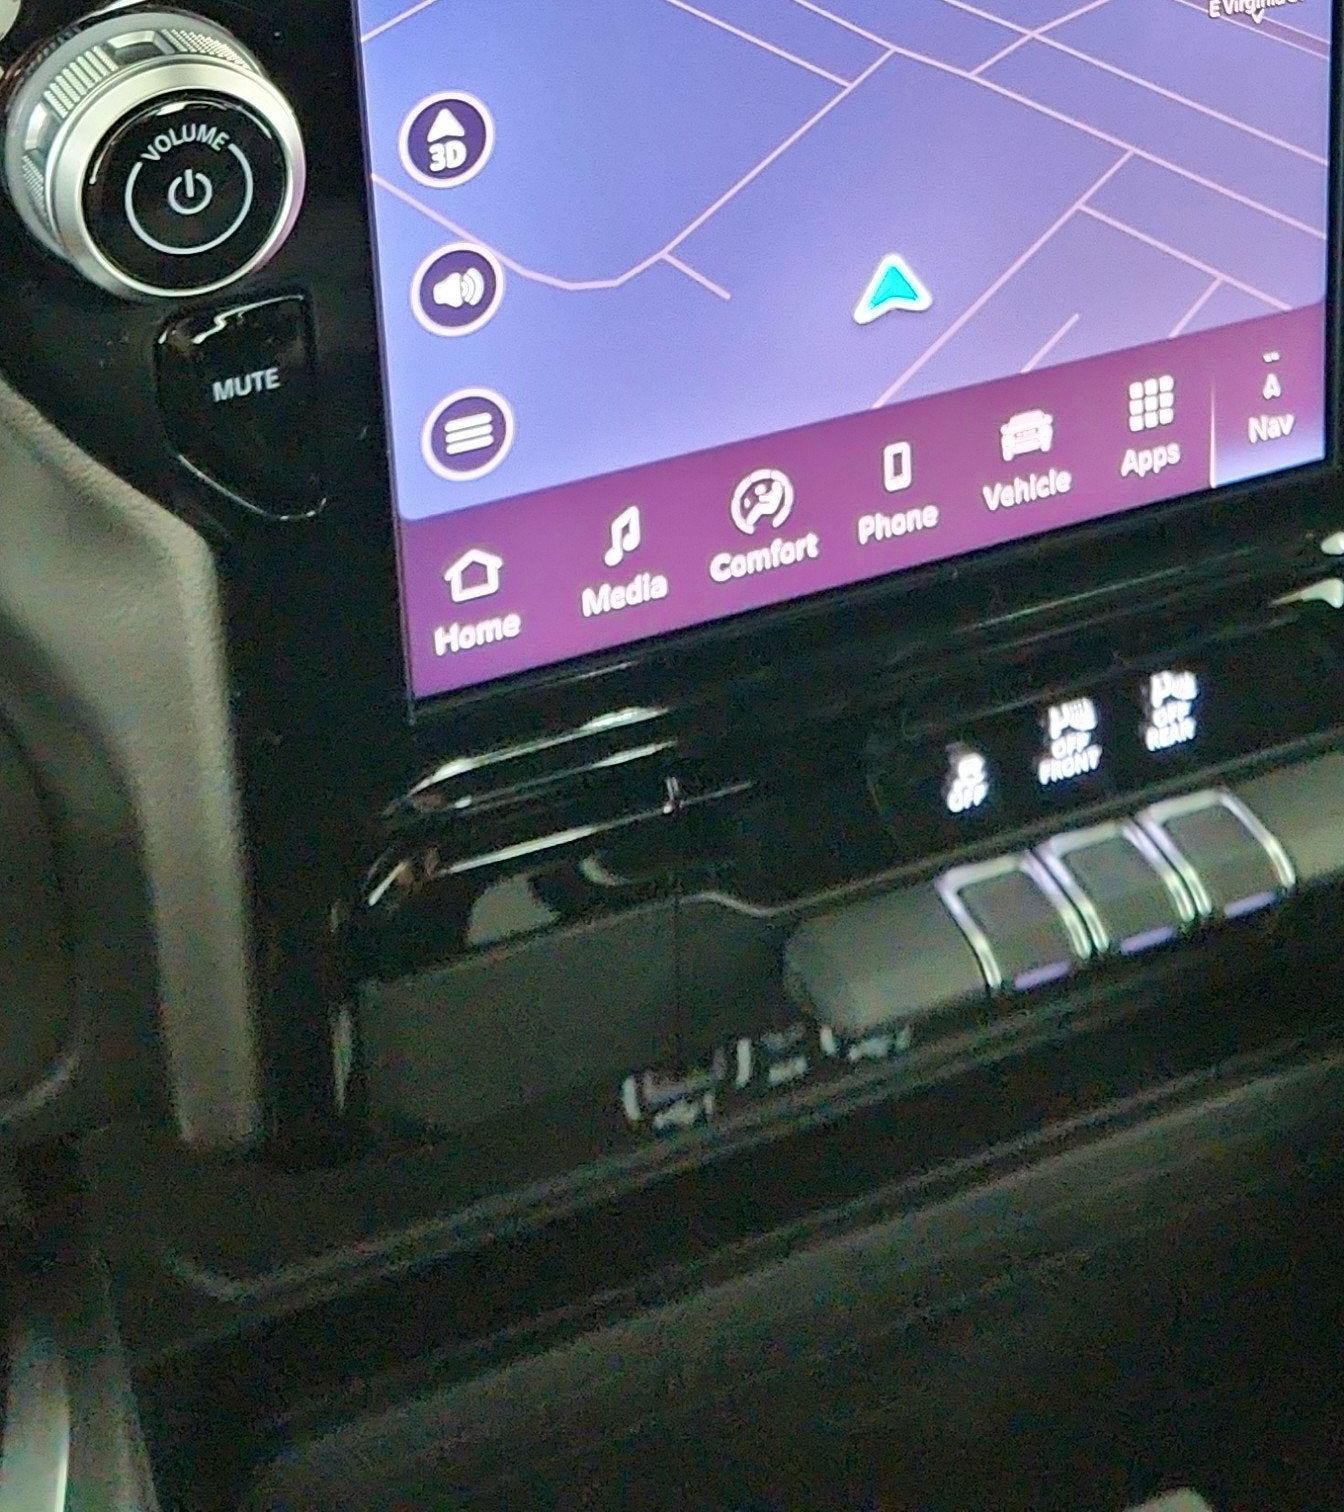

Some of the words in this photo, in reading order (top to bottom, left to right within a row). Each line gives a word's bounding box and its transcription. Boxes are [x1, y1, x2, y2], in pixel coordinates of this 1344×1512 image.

[1209, 0, 1221, 18] E
[140, 123, 230, 162] VOLUME
[429, 139, 467, 172] 3D
[212, 367, 280, 402] MUTE
[1247, 413, 1295, 444] Nav
[1120, 443, 1181, 478] Apps
[982, 468, 1072, 512] Vehicle
[858, 505, 939, 545] Phone
[710, 533, 819, 582] Comfort
[582, 572, 668, 618] Media
[434, 613, 521, 656] Home
[1152, 700, 1192, 730] OFF
[1051, 730, 1092, 760] OFF
[1145, 715, 1197, 752] REAR
[1038, 744, 1103, 786] FRONT
[946, 778, 990, 813] OFF
